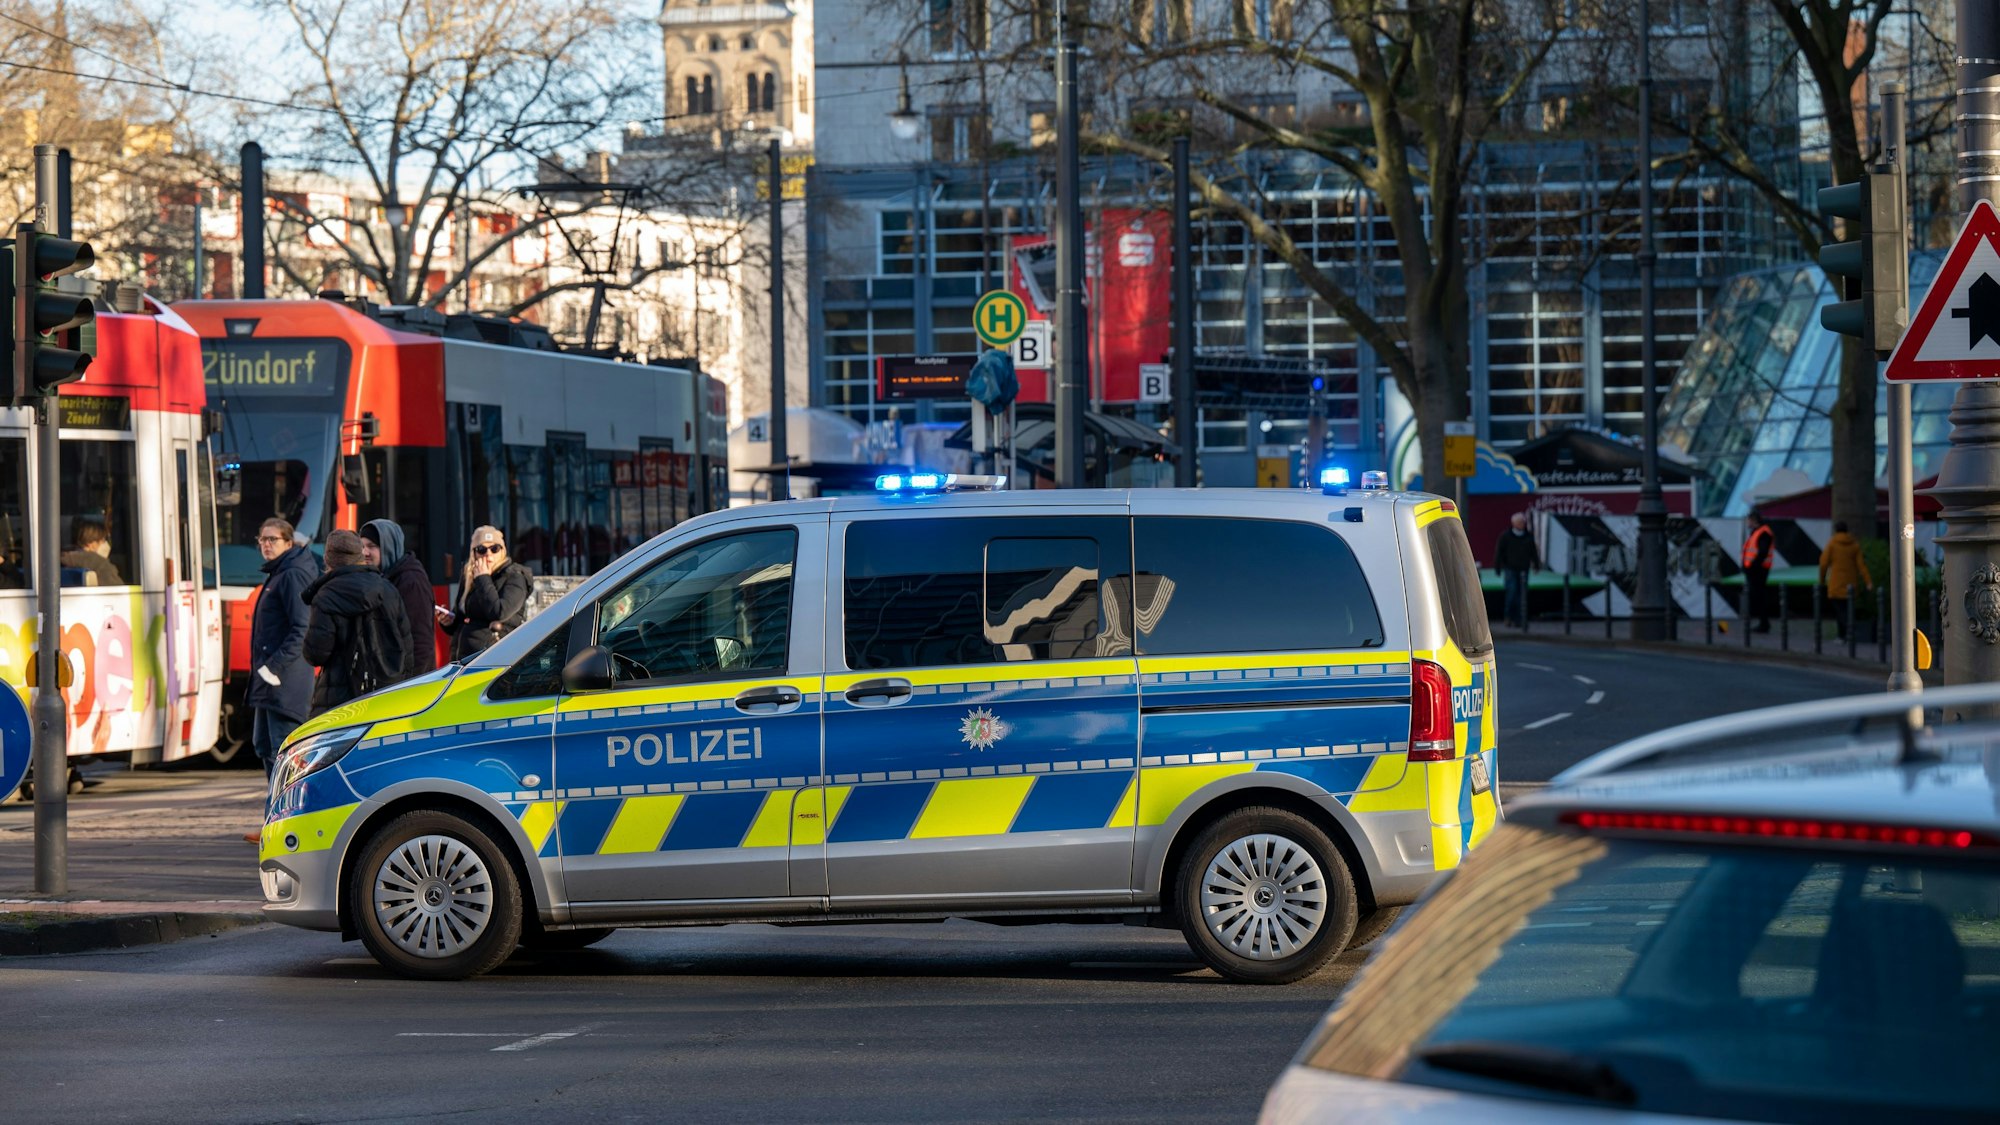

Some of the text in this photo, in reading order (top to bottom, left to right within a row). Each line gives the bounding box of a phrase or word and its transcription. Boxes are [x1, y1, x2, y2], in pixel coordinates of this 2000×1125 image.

[988, 304, 1013, 333] H
[1020, 337, 1039, 362] B
[202, 350, 317, 385] Zündorf
[1146, 376, 1161, 396] B
[751, 425, 762, 441] 4
[1534, 468, 1618, 484] ratenteam
[607, 726, 763, 768] POLIZEI
